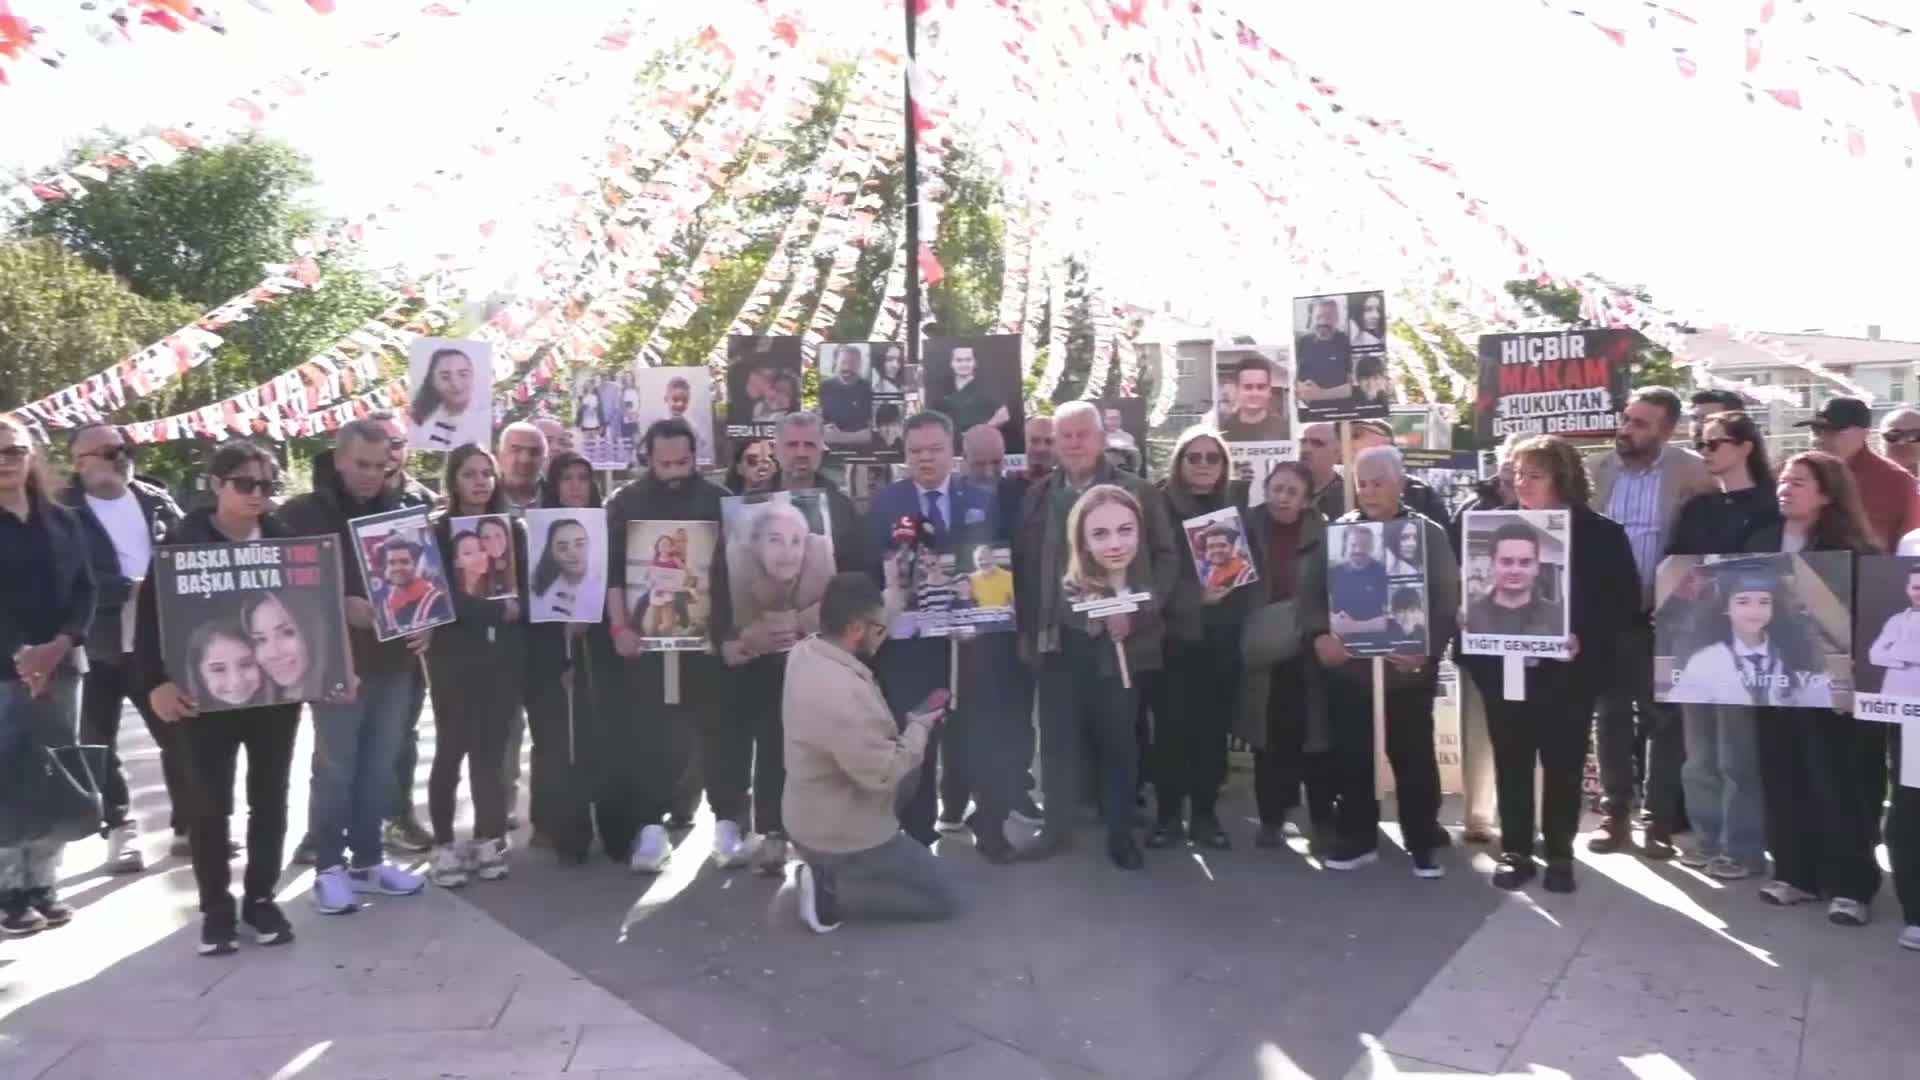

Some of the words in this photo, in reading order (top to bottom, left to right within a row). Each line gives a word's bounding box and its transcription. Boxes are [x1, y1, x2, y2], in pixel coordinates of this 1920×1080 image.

[1501, 333, 1585, 366] HİÇBİR
[1499, 358, 1608, 392] MAKAM
[1510, 391, 1602, 415] HUKUKTAN
[1492, 418, 1544, 437] ÜSTÜN
[175, 548, 230, 571] BAŞKA
[176, 570, 235, 599] BAŞKA
[240, 569, 282, 589] ALYA
